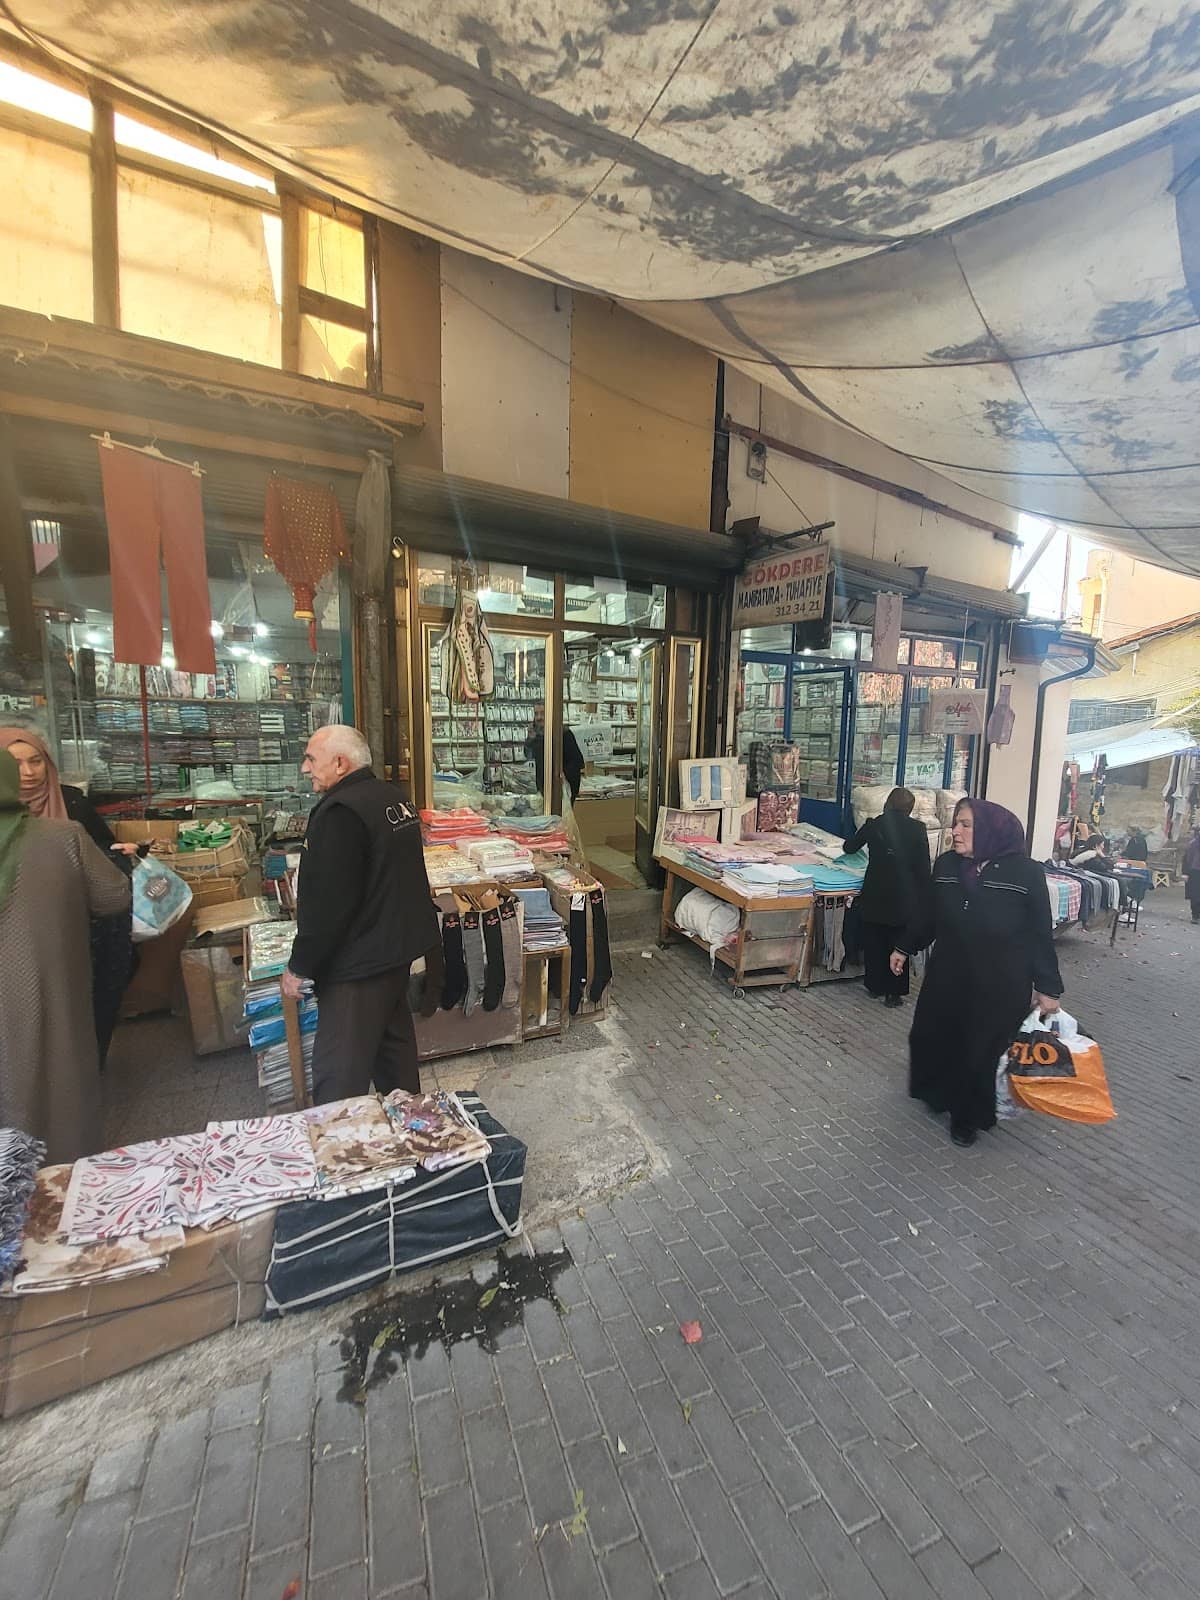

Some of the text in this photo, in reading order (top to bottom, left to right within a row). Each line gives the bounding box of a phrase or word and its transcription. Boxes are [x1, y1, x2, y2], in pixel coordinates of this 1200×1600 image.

[742, 553, 825, 586] GÖKDERE
[775, 600, 820, 617] 312 34 21
